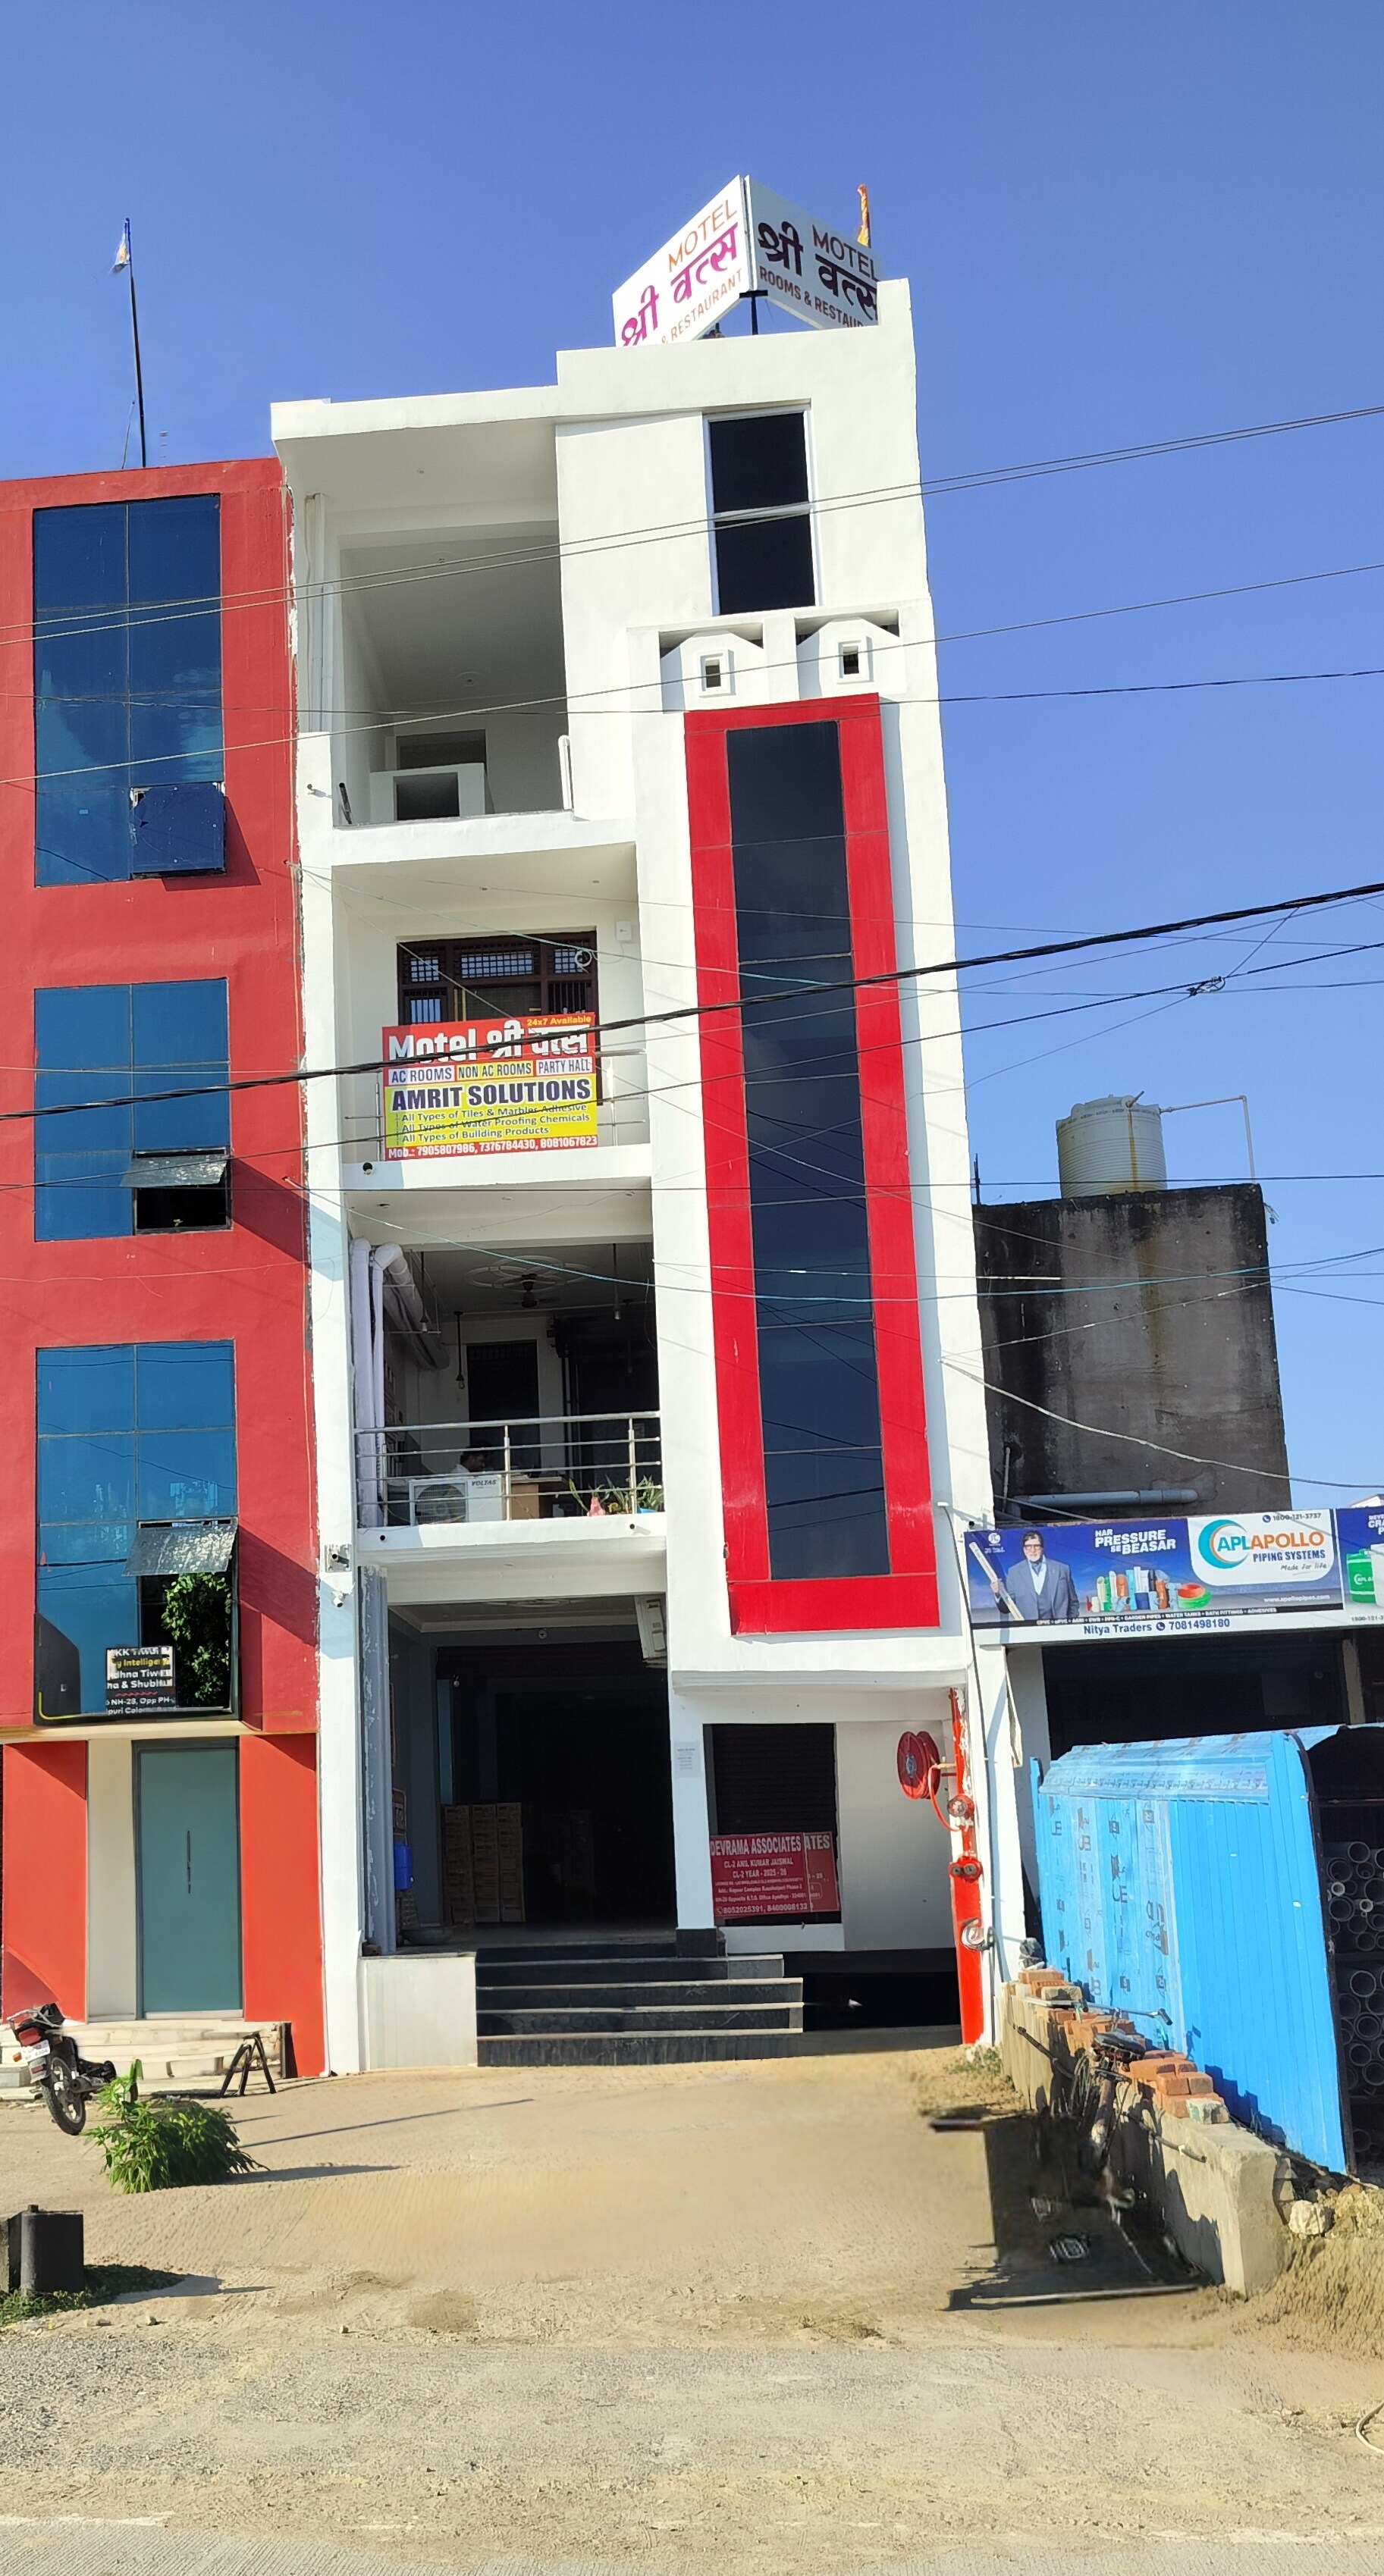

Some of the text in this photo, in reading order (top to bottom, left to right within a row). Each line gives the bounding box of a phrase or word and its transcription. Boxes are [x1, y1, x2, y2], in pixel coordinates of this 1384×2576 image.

[668, 199, 737, 273] MOTEL
[758, 221, 804, 277] श्री
[812, 224, 880, 281] MOTEL
[622, 222, 738, 346] श्री वत्स
[760, 266, 801, 300] ROOMS
[804, 291, 812, 307] &
[671, 268, 742, 341] RESTAURANT
[527, 1015, 592, 1026] 24x7 Available
[389, 1029, 476, 1063] Motel
[459, 1062, 532, 1079] NON AC ROOMS
[539, 1058, 590, 1073] PARTY HALL
[391, 1067, 452, 1083] AC ROOMS
[393, 1079, 591, 1111] AMRIT SOLUTIONS
[418, 1112, 445, 1122] Types
[448, 1111, 459, 1119] of
[461, 1110, 483, 1119] Tiles
[486, 1108, 494, 1117] &
[498, 1107, 538, 1116] Marbles
[541, 1104, 587, 1113] Adhesive
[402, 1114, 590, 1133] All Types of Water Proofing Chemicals
[419, 1133, 446, 1142] Types
[449, 1131, 459, 1139] of
[463, 1130, 502, 1139] Building
[505, 1127, 549, 1136] Products
[541, 1136, 598, 1149] 8081067823
[1273, 1512, 1321, 1521] 1800-121-3737
[1095, 1529, 1166, 1548] PRESSURE
[1122, 1539, 1176, 1555] BEASAR
[1253, 1550, 1326, 1562] PIPING SYSTEMS
[1264, 1594, 1330, 1603] www.apollopipes.com
[1084, 1619, 1230, 1635] Nitya Traders 7081498180
[752, 1835, 802, 1854] ASSOCIATES
